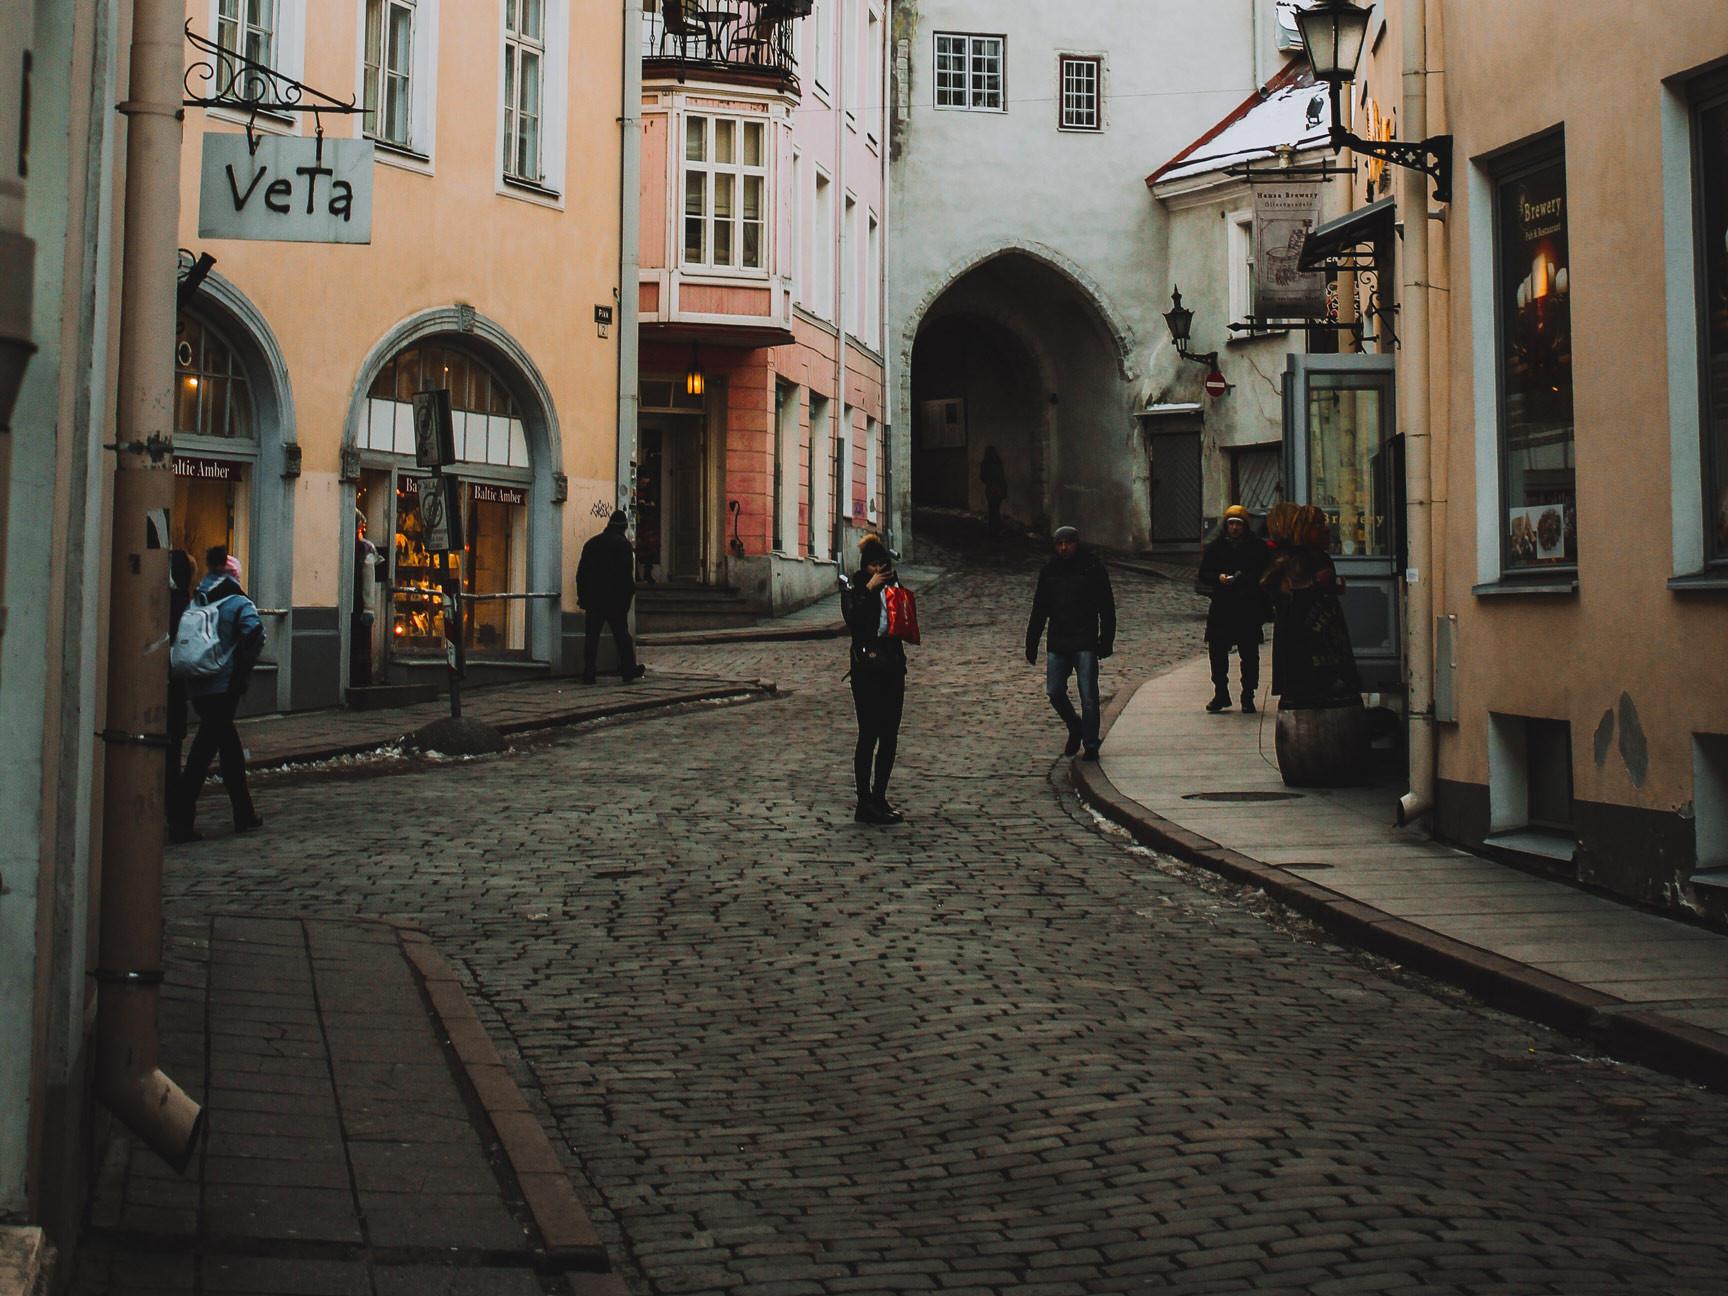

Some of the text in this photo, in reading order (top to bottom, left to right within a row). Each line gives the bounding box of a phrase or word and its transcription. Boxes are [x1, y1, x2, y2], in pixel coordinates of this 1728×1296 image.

[225, 164, 353, 222] VeTa
[1524, 197, 1561, 222] Brewery
[172, 458, 230, 479] altic Amber
[474, 485, 522, 504] Baltic Amber
